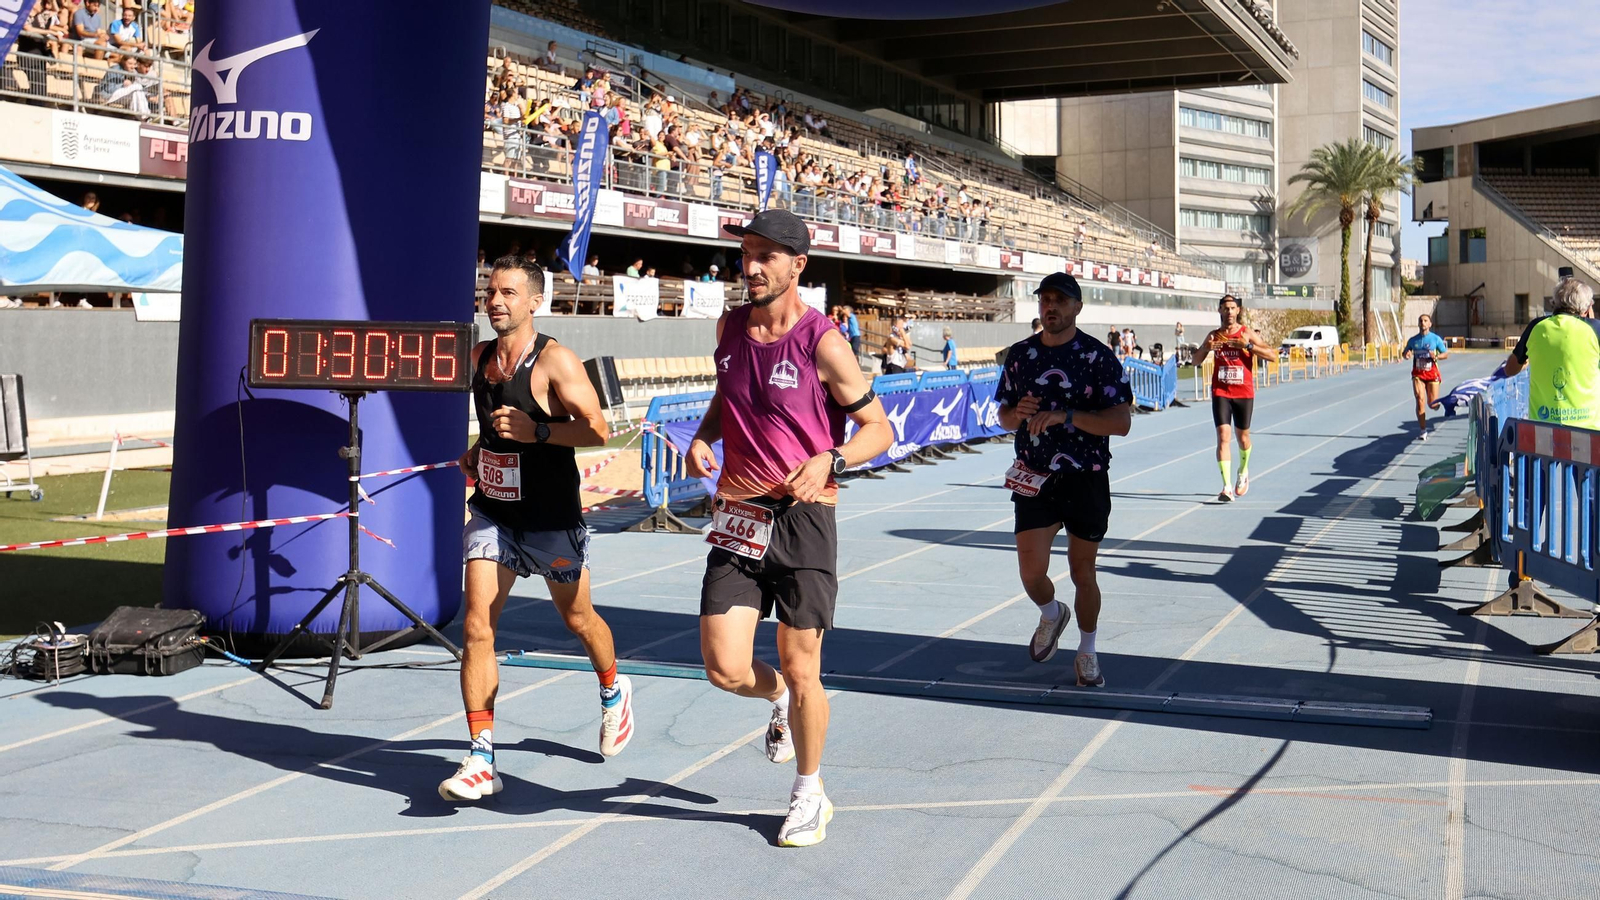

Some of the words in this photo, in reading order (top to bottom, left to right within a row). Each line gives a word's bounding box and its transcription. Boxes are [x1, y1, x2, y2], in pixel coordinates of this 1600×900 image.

[190, 104, 312, 143] MIZUNO
[83, 134, 131, 147] Ayuntamiento
[150, 138, 188, 163] PLA
[512, 187, 541, 205] PLAY
[534, 186, 575, 213] JEREZ
[626, 203, 653, 219] PLAY
[263, 329, 456, 381] 01:30:46
[1550, 407, 1589, 416] Atletismo
[483, 465, 504, 485] 508
[487, 488, 516, 498] MIZUNO
[726, 517, 756, 539] 466
[726, 541, 761, 556] MIZUNO
